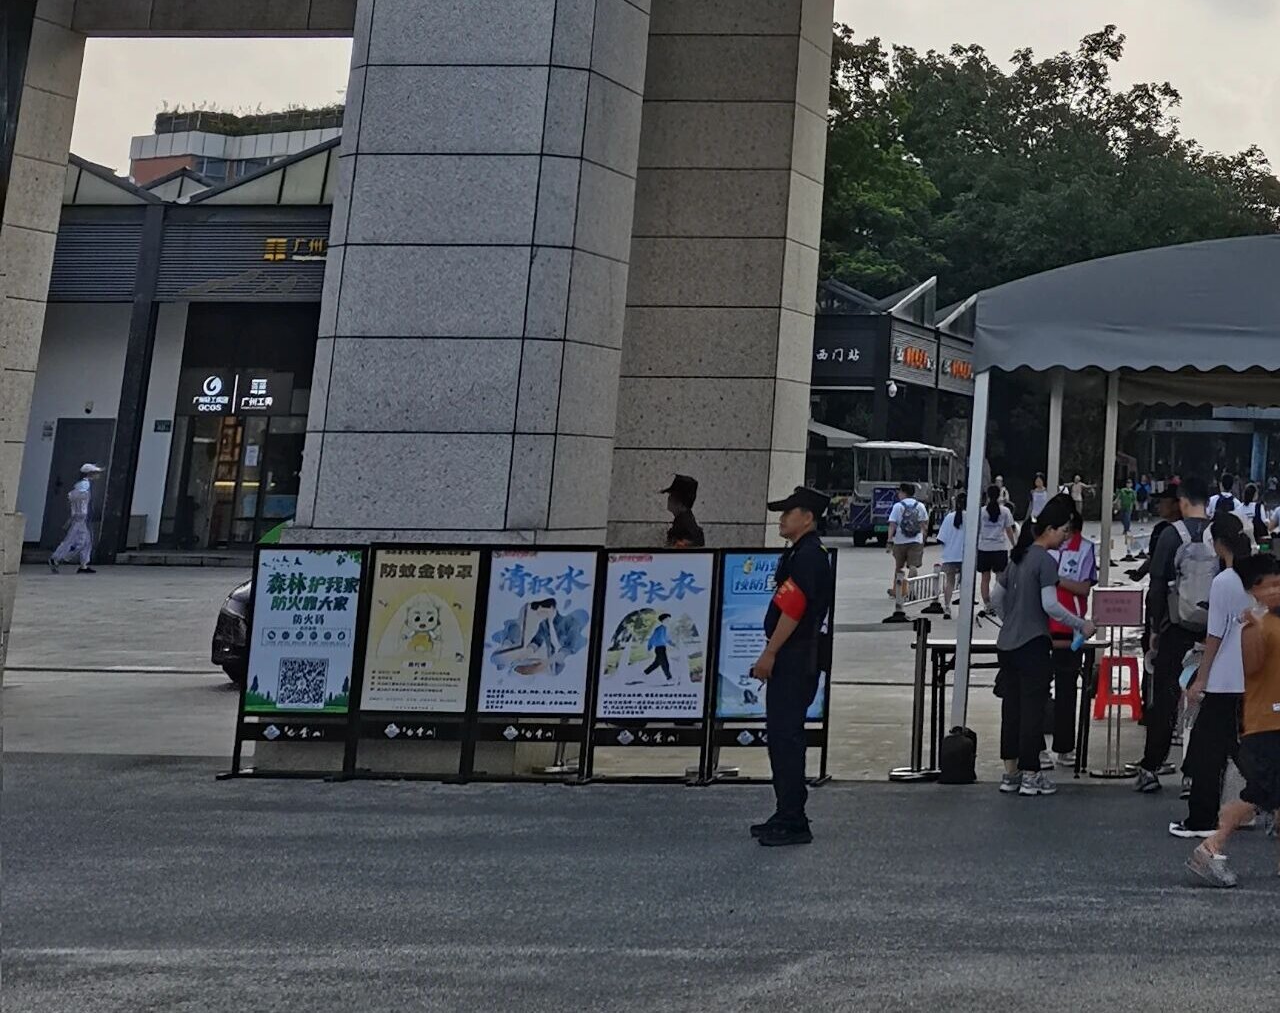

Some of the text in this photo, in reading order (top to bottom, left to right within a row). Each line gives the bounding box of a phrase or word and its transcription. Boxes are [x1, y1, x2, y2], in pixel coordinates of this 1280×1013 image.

[816, 348, 860, 362] 西门站
[380, 563, 473, 580] 防蚊金钟罩
[499, 563, 592, 599] 清积水
[266, 572, 360, 595] 森林护我家
[619, 570, 705, 604] 穿长衣
[270, 595, 350, 612] 防火靠大家
